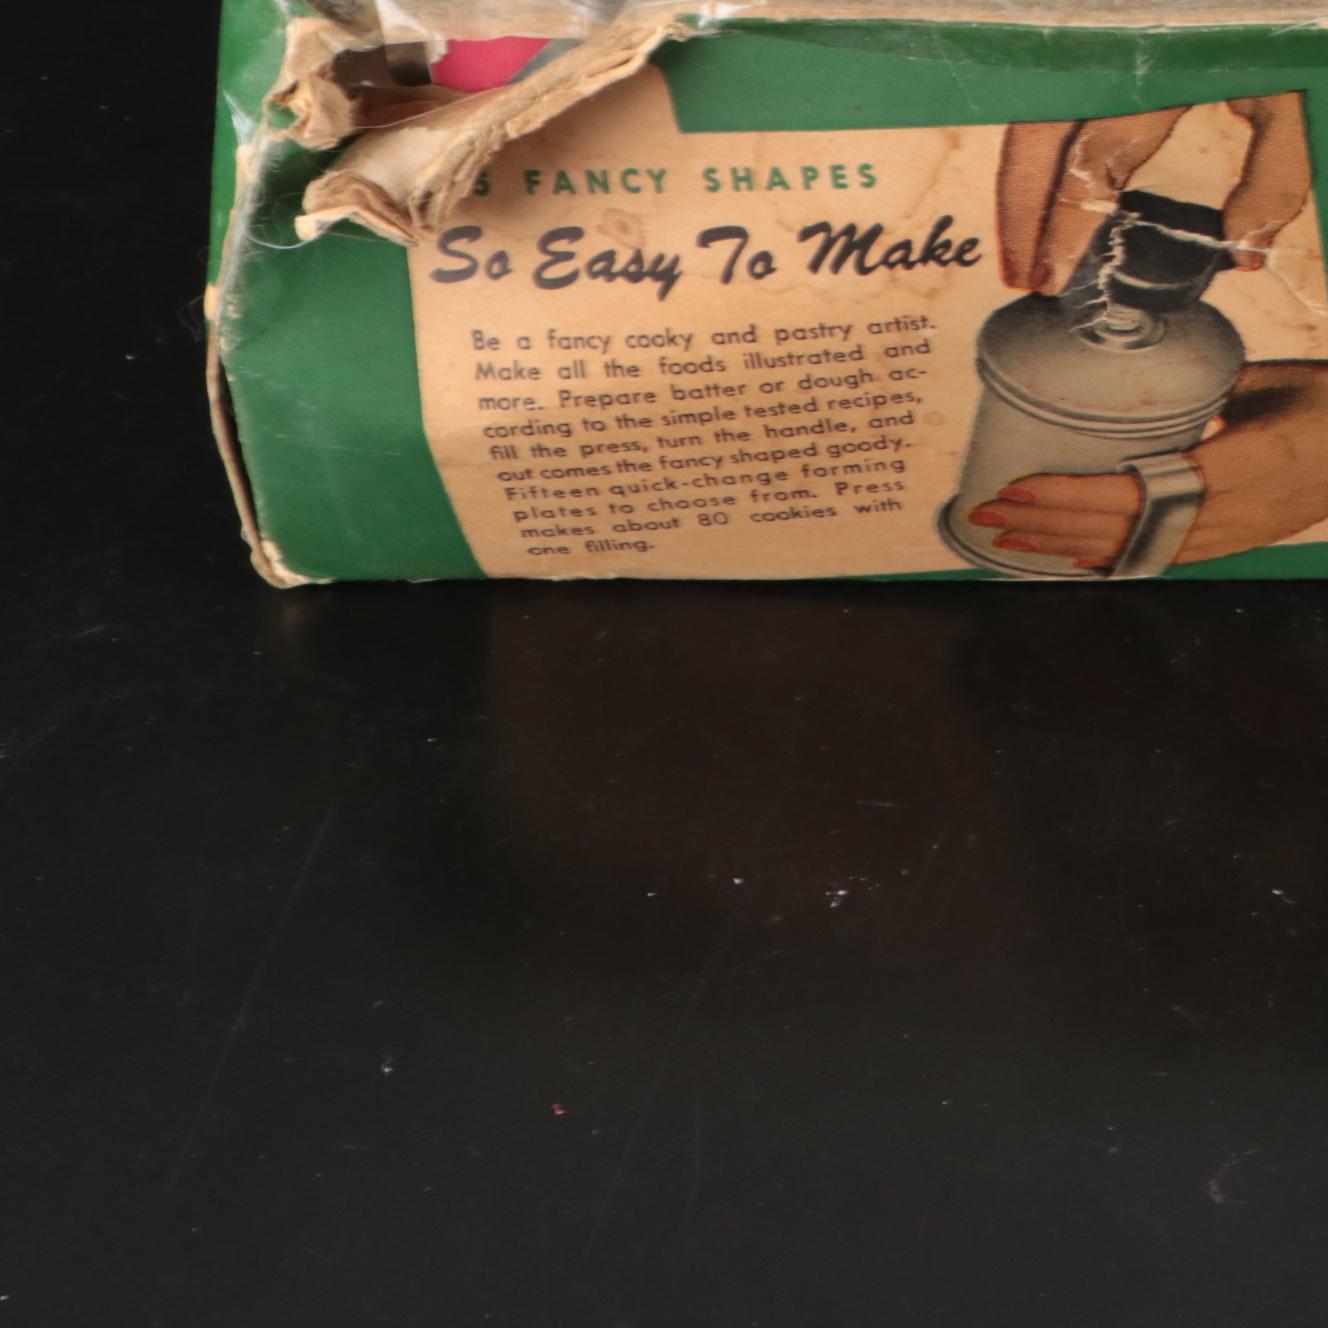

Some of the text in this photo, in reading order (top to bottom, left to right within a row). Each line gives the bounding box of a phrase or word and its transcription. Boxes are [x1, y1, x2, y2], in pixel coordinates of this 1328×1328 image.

[524, 168, 667, 195] FANCY
[702, 163, 877, 193] SHAPES
[430, 214, 983, 302] So Easy To Make
[471, 315, 937, 354] Be a fancy cooky and pastry artist.
[475, 338, 931, 381] Make all the foods illustrated and
[478, 368, 927, 411] more. Prepare batter or dough ac-
[482, 390, 923, 438] cording to the simple tested recipes,
[489, 409, 914, 460] fill the press, turn the handle, and
[497, 468, 533, 481] out
[539, 464, 611, 480] comes
[616, 459, 653, 472] the
[658, 453, 724, 470] fancy
[730, 442, 819, 464] shaped
[503, 458, 906, 501] Fifteen quick-change forming
[513, 480, 905, 524] plates to choose from. Press
[521, 498, 902, 538] makes about 80 cookies with
[527, 539, 656, 556] one filling.
